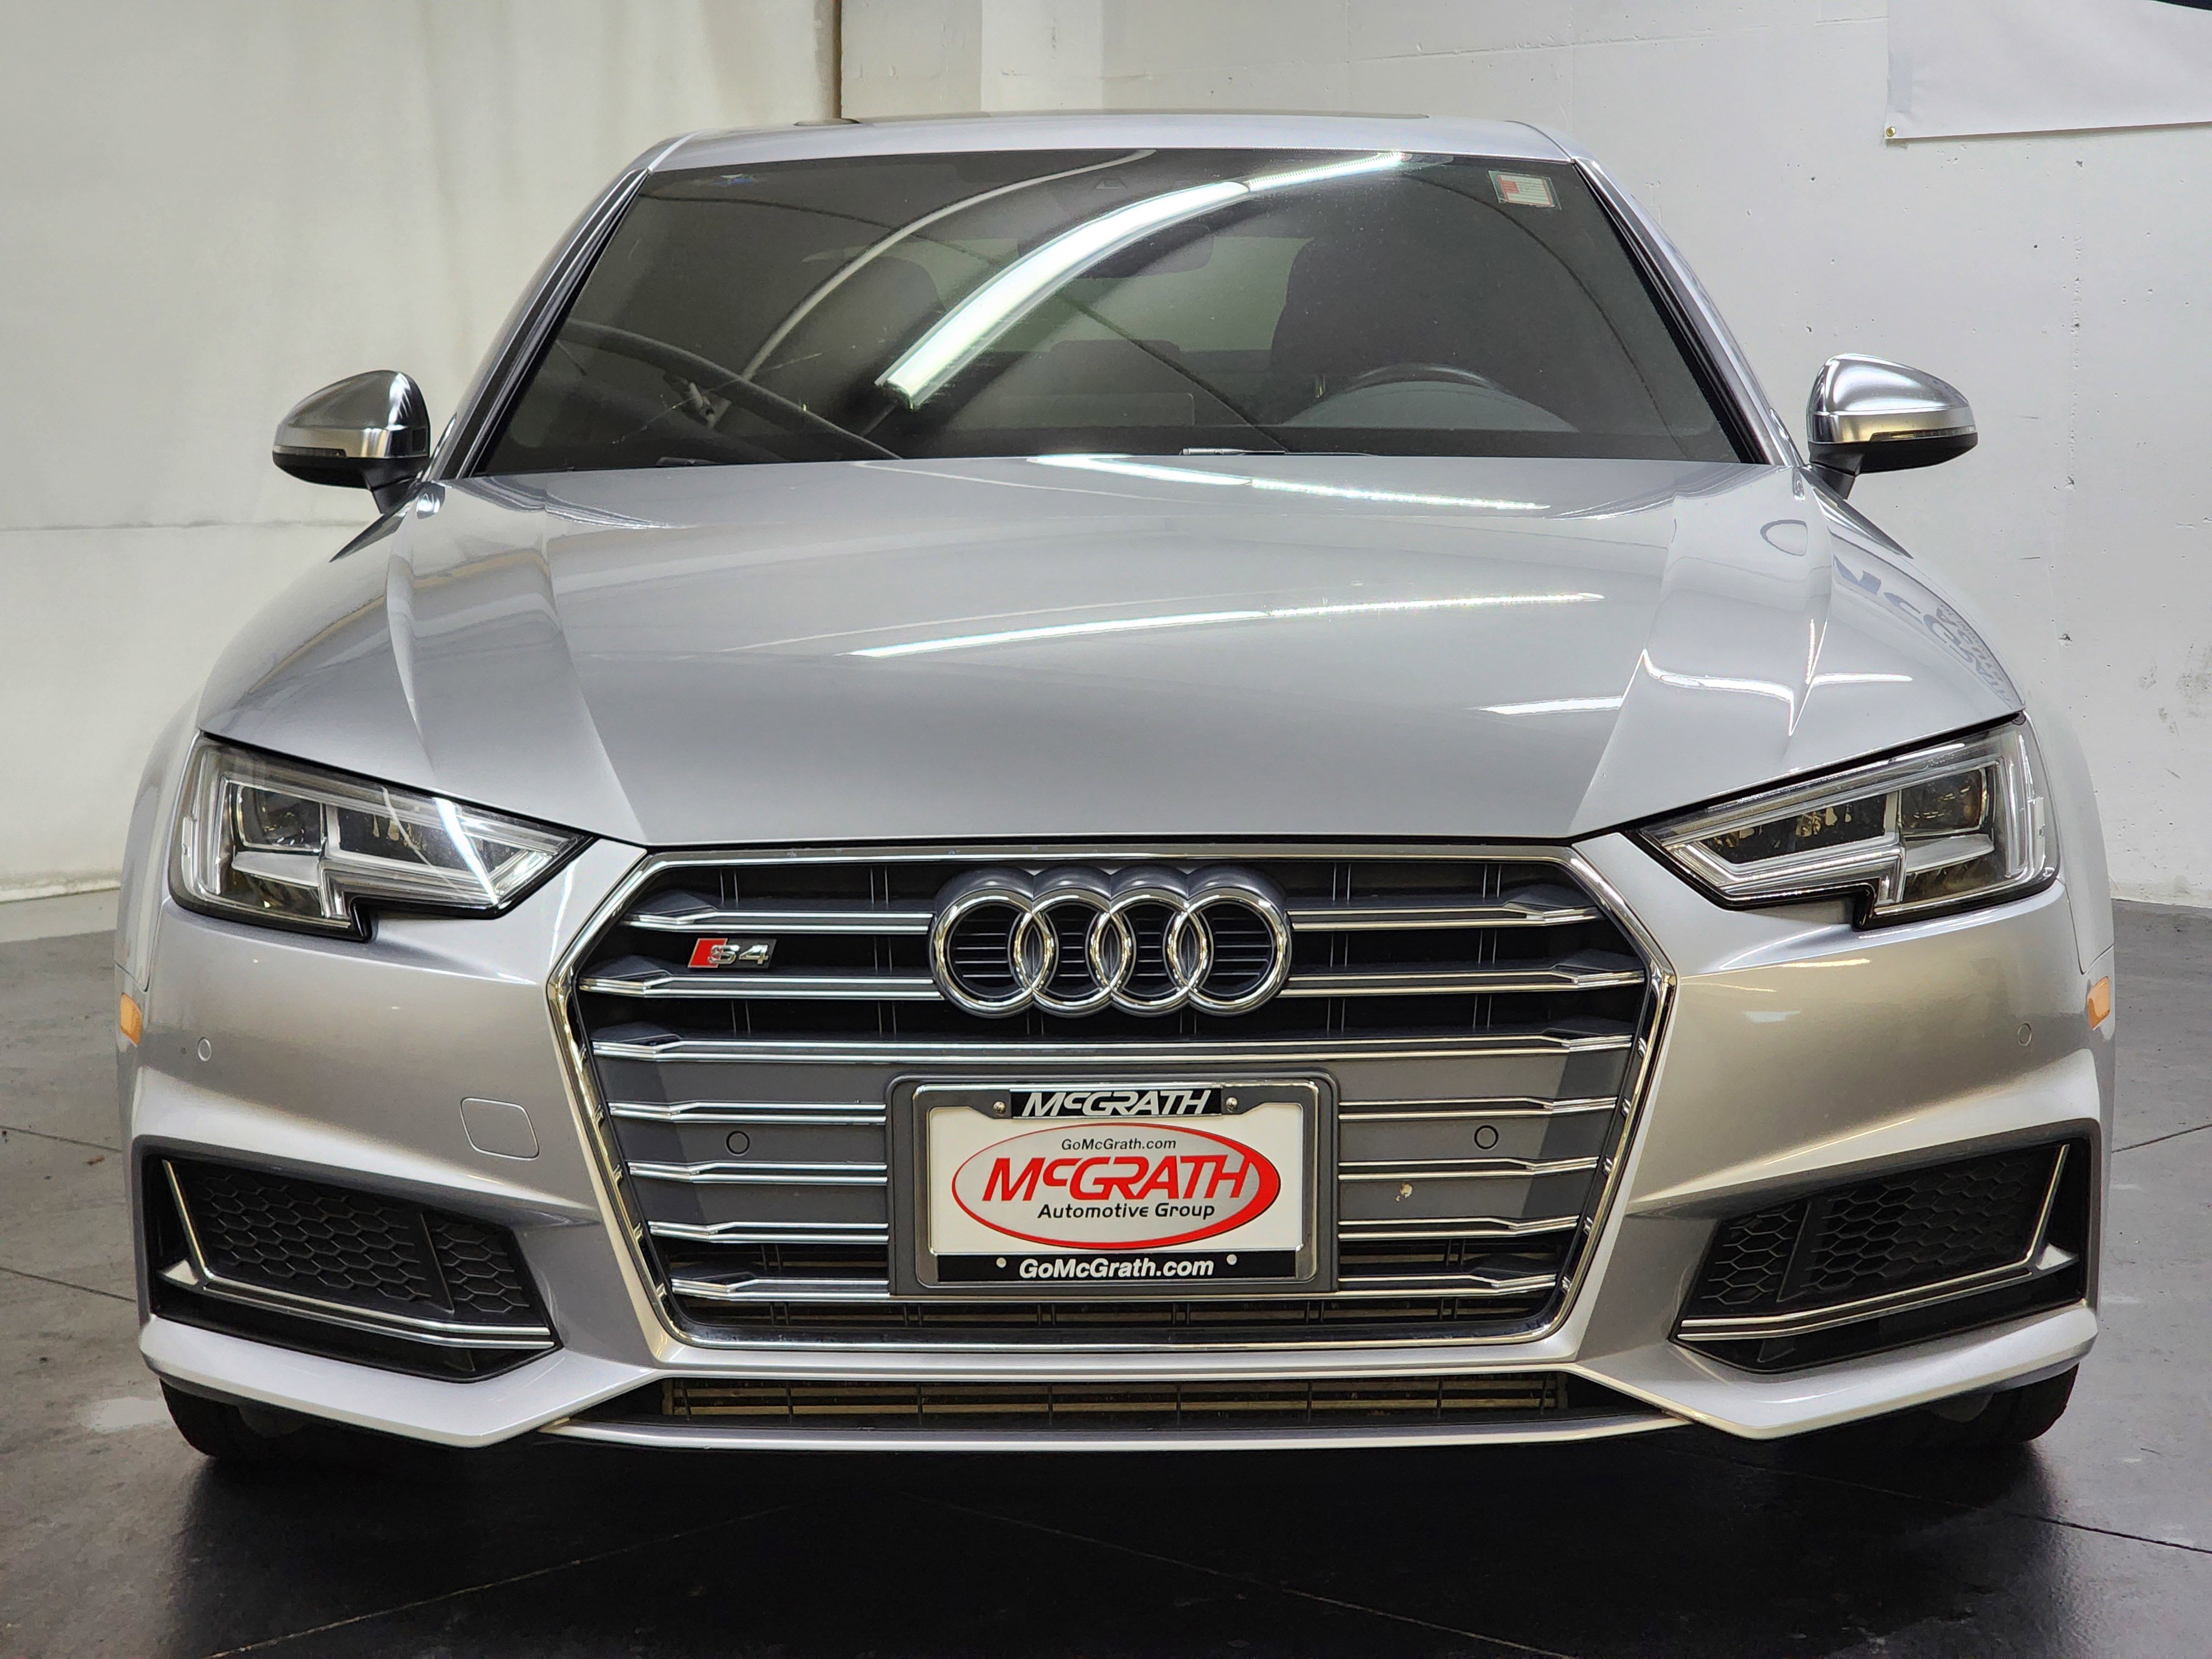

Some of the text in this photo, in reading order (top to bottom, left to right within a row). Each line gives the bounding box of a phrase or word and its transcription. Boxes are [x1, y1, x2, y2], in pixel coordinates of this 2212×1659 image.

[707, 943, 770, 965] S4
[1061, 1138, 1177, 1150] GoMcGrath.com
[1037, 1202, 1215, 1220] Automotive Group
[1019, 1258, 1214, 1279] GoMcGrath.com
